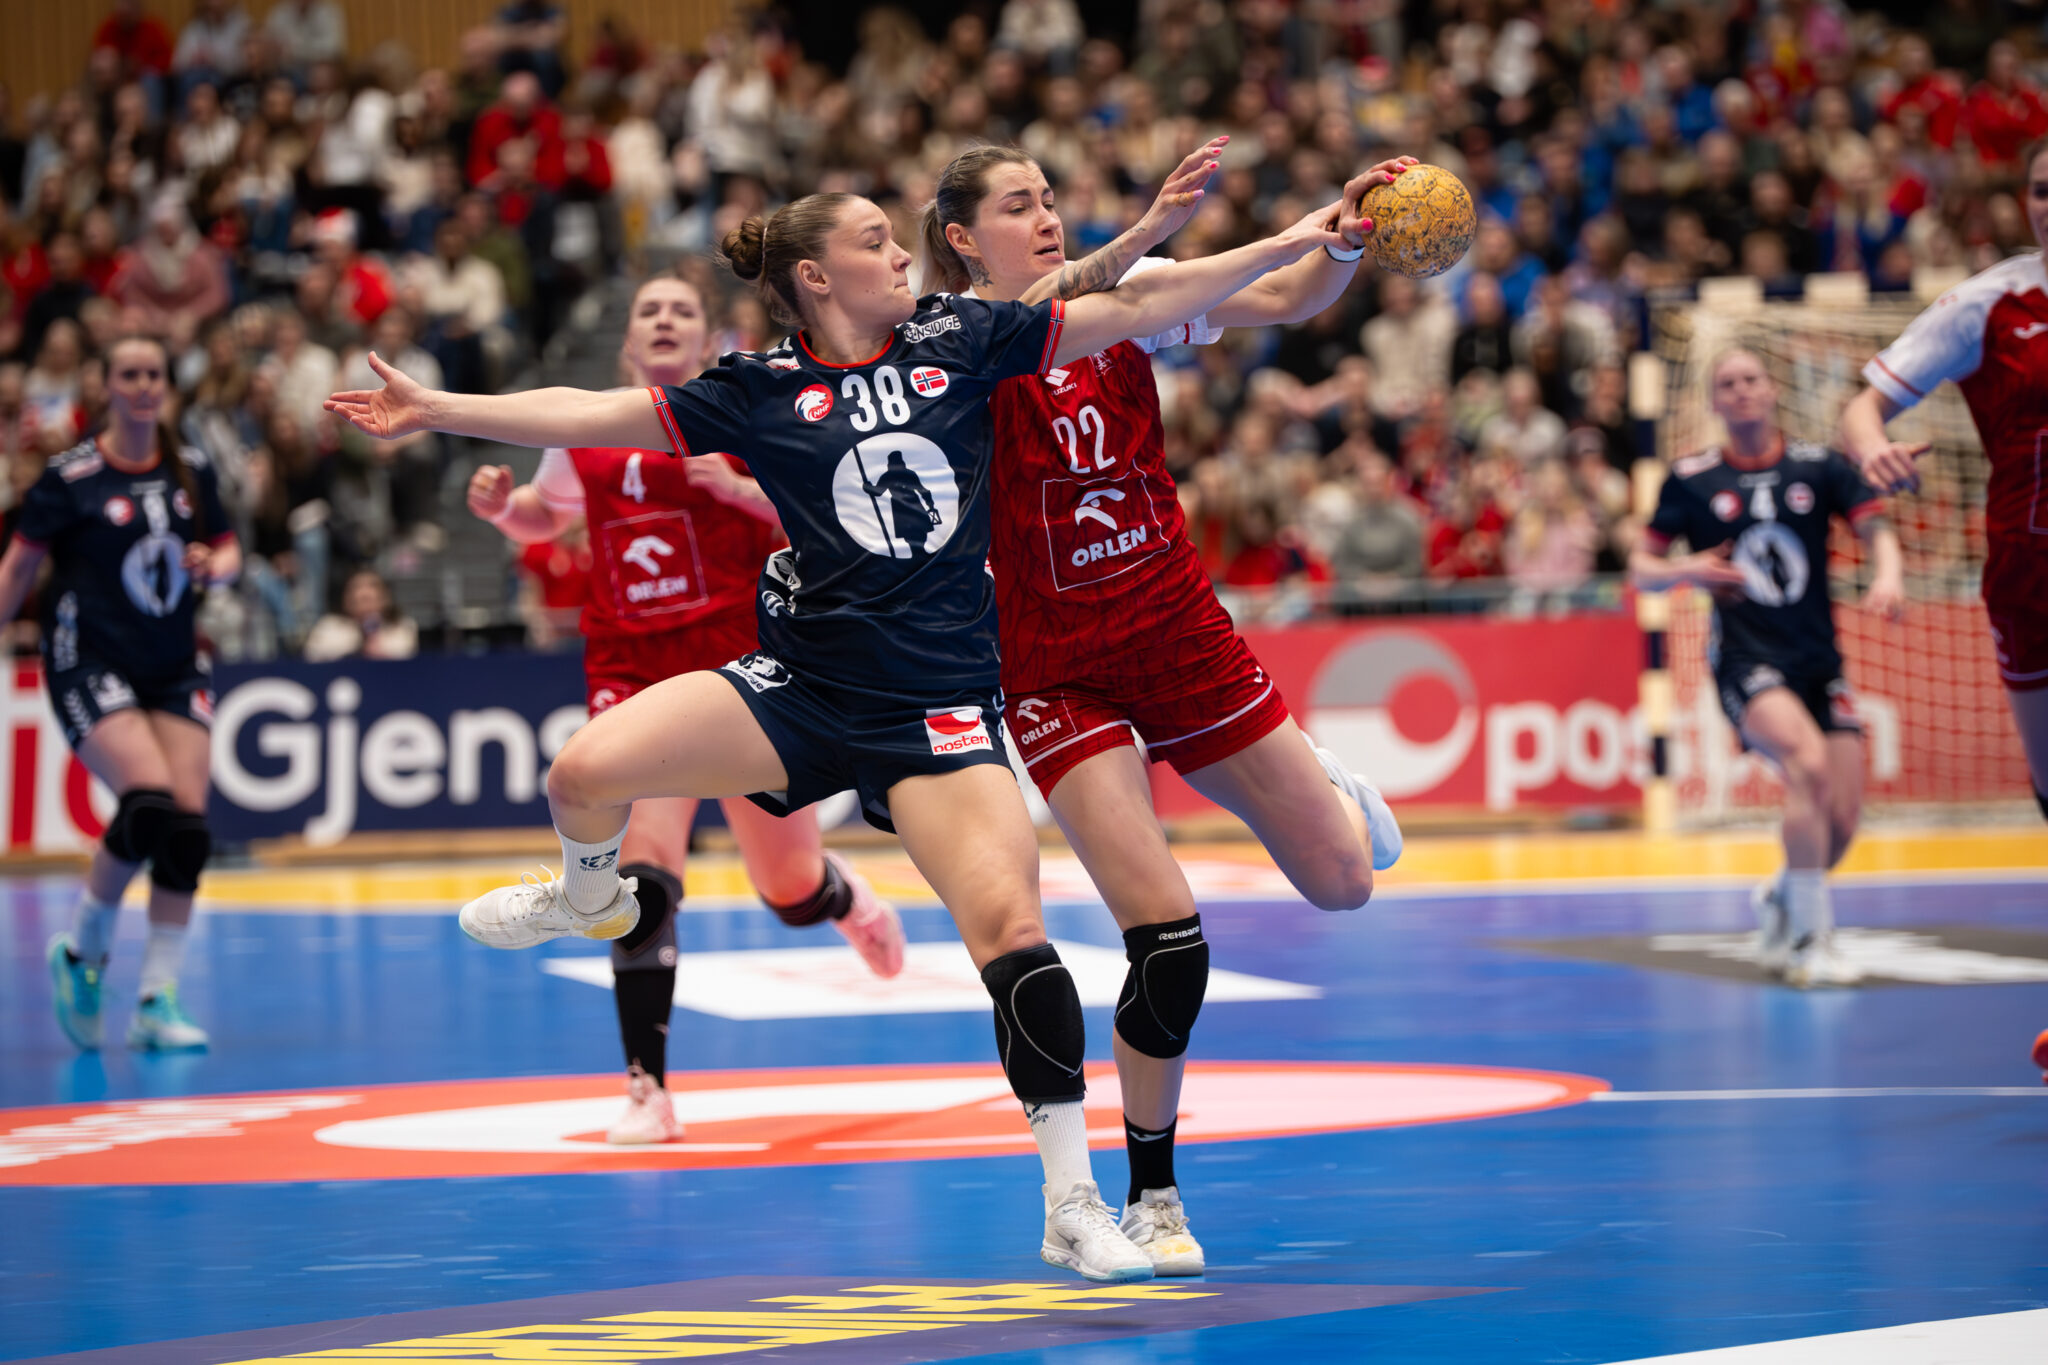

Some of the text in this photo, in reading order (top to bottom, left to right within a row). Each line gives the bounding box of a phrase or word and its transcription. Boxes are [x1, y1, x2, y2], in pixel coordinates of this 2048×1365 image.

[813, 402, 830, 418] NHF
[840, 365, 911, 432] 38
[1051, 405, 1117, 474] 22
[622, 452, 647, 504] 4
[1071, 525, 1148, 567] ORLEN
[626, 575, 689, 603] ORLEN
[1020, 718, 1062, 745] ORLEN
